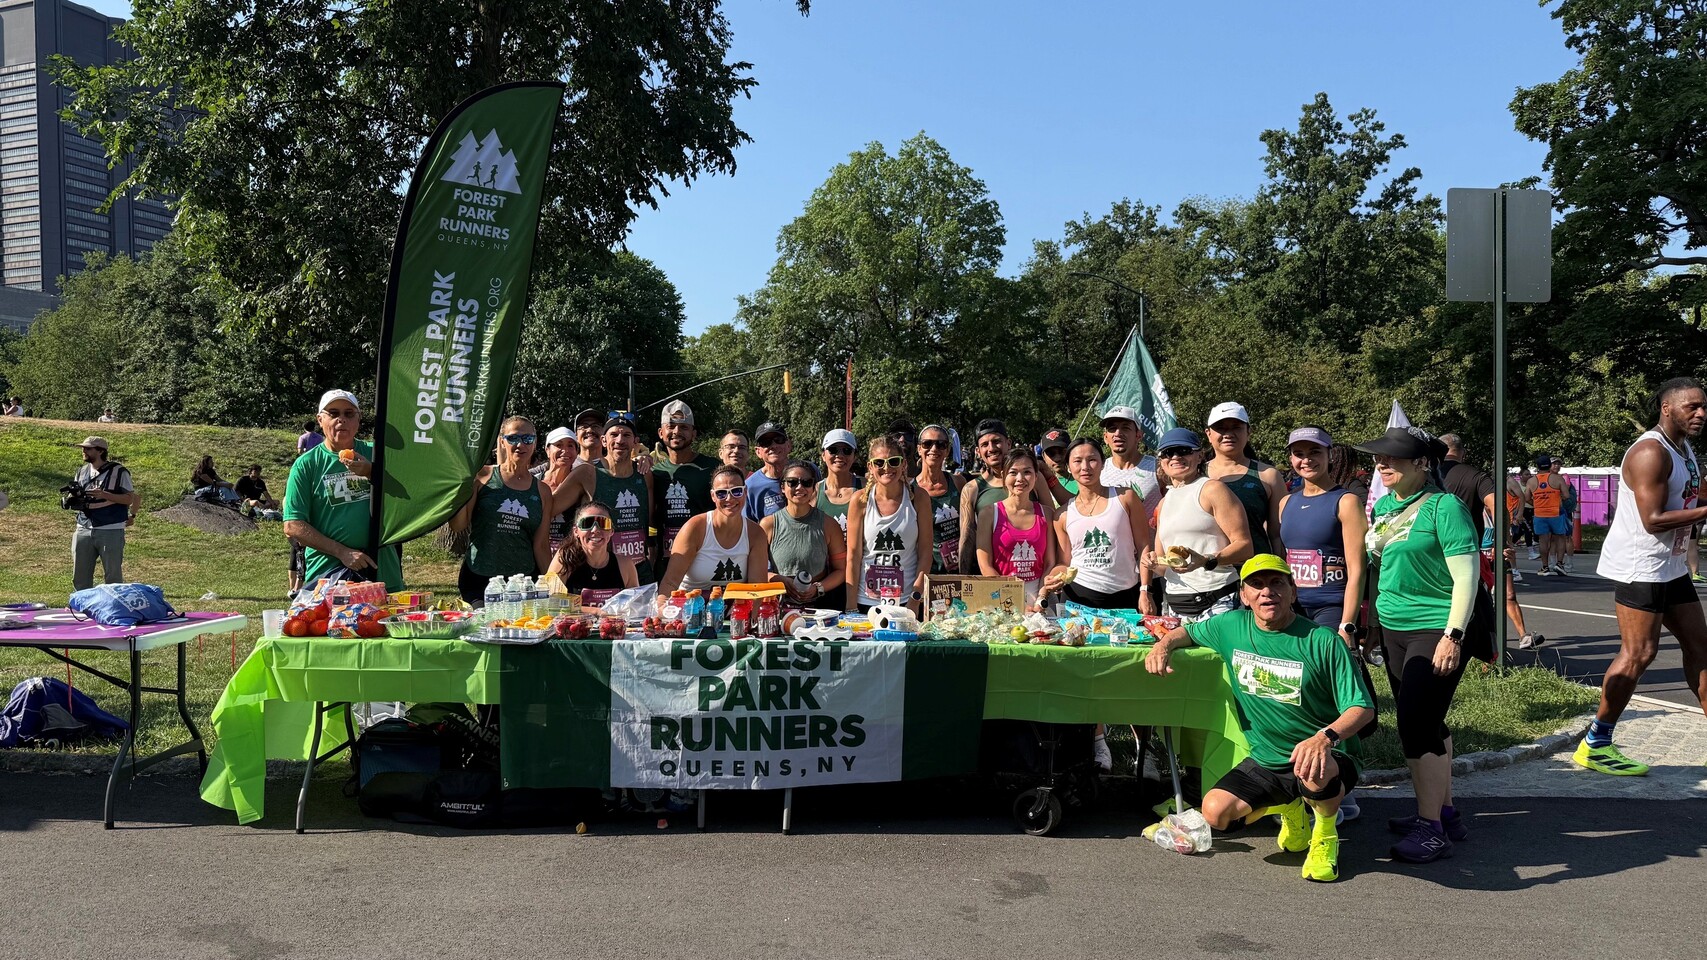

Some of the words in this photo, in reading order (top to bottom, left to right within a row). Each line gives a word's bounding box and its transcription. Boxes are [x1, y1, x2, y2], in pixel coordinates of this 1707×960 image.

[453, 188, 507, 208] FOREST
[457, 205, 497, 222] PARK
[440, 217, 510, 240] RUNNERS
[425, 269, 456, 341] PARK
[441, 298, 480, 423] RUNNERS
[467, 277, 502, 449] FORESTPARKRUNNERS.ORG
[413, 347, 444, 444] FOREST
[334, 479, 352, 502] 4
[497, 523, 521, 531] RUNNERS
[501, 513, 523, 522] FOREST
[621, 541, 645, 556] 4035
[874, 553, 901, 566] FPR
[1290, 563, 1318, 581] 5726
[964, 583, 973, 592] 30
[670, 640, 850, 671] FOREST
[1234, 651, 1255, 660] FOREST
[1270, 659, 1302, 669] RUNNERS
[1237, 663, 1257, 695] 4
[697, 675, 821, 711] PARK
[650, 714, 866, 751] RUNNERS
